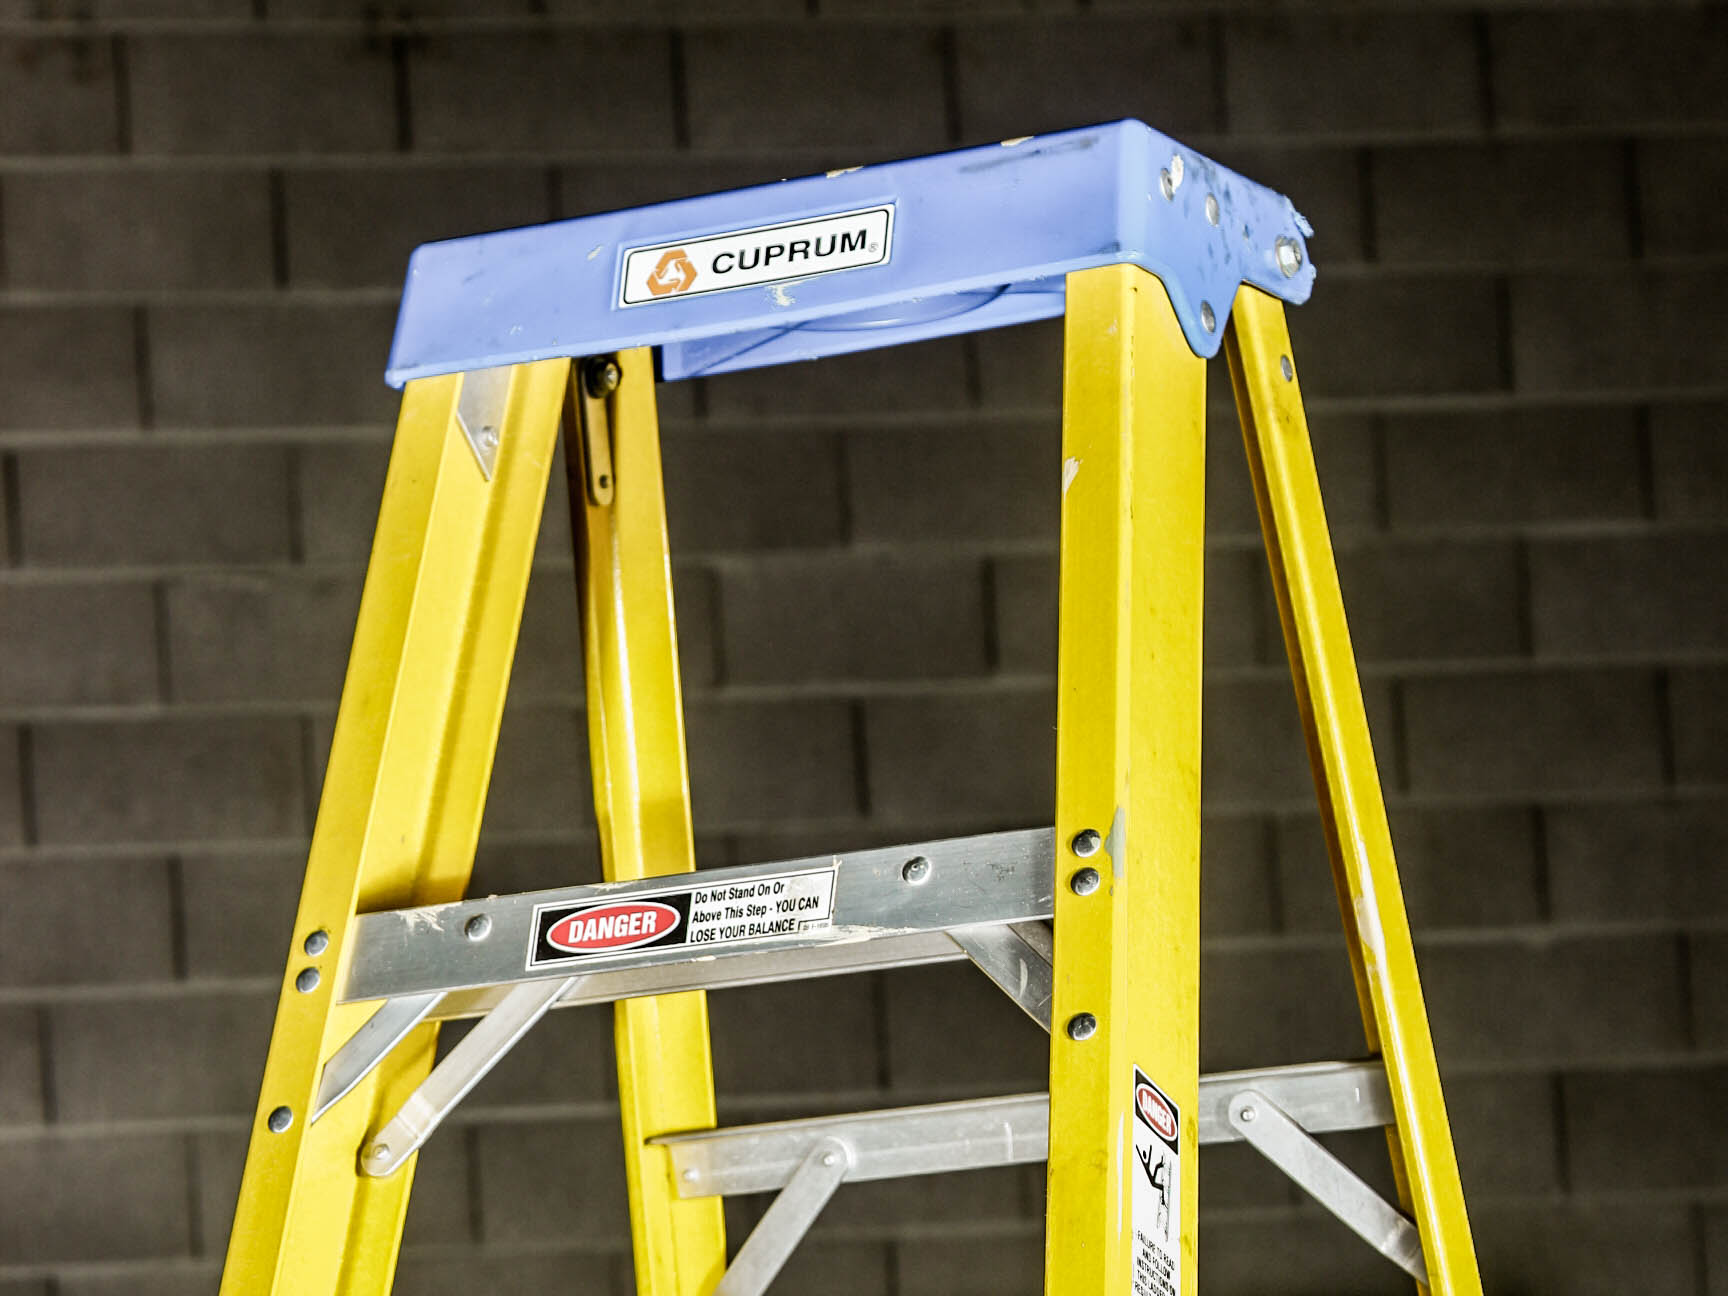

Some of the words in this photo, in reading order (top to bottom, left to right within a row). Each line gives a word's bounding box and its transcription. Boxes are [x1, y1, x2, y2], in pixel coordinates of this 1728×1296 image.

[711, 229, 868, 274] CUPRUM
[694, 890, 708, 905] Do
[710, 888, 727, 902] Not
[728, 885, 755, 900] Stand
[757, 883, 771, 896] On
[772, 881, 785, 895] Or
[691, 907, 722, 924] Above
[724, 904, 744, 919] This
[746, 900, 768, 919] Step
[775, 898, 797, 914] YOU
[798, 895, 820, 911] CAN
[567, 910, 658, 944] DANGER
[690, 928, 717, 944] LOSE
[719, 924, 747, 940] YOUR
[748, 918, 795, 936] BALANCE
[1142, 1089, 1172, 1136] DANGER
